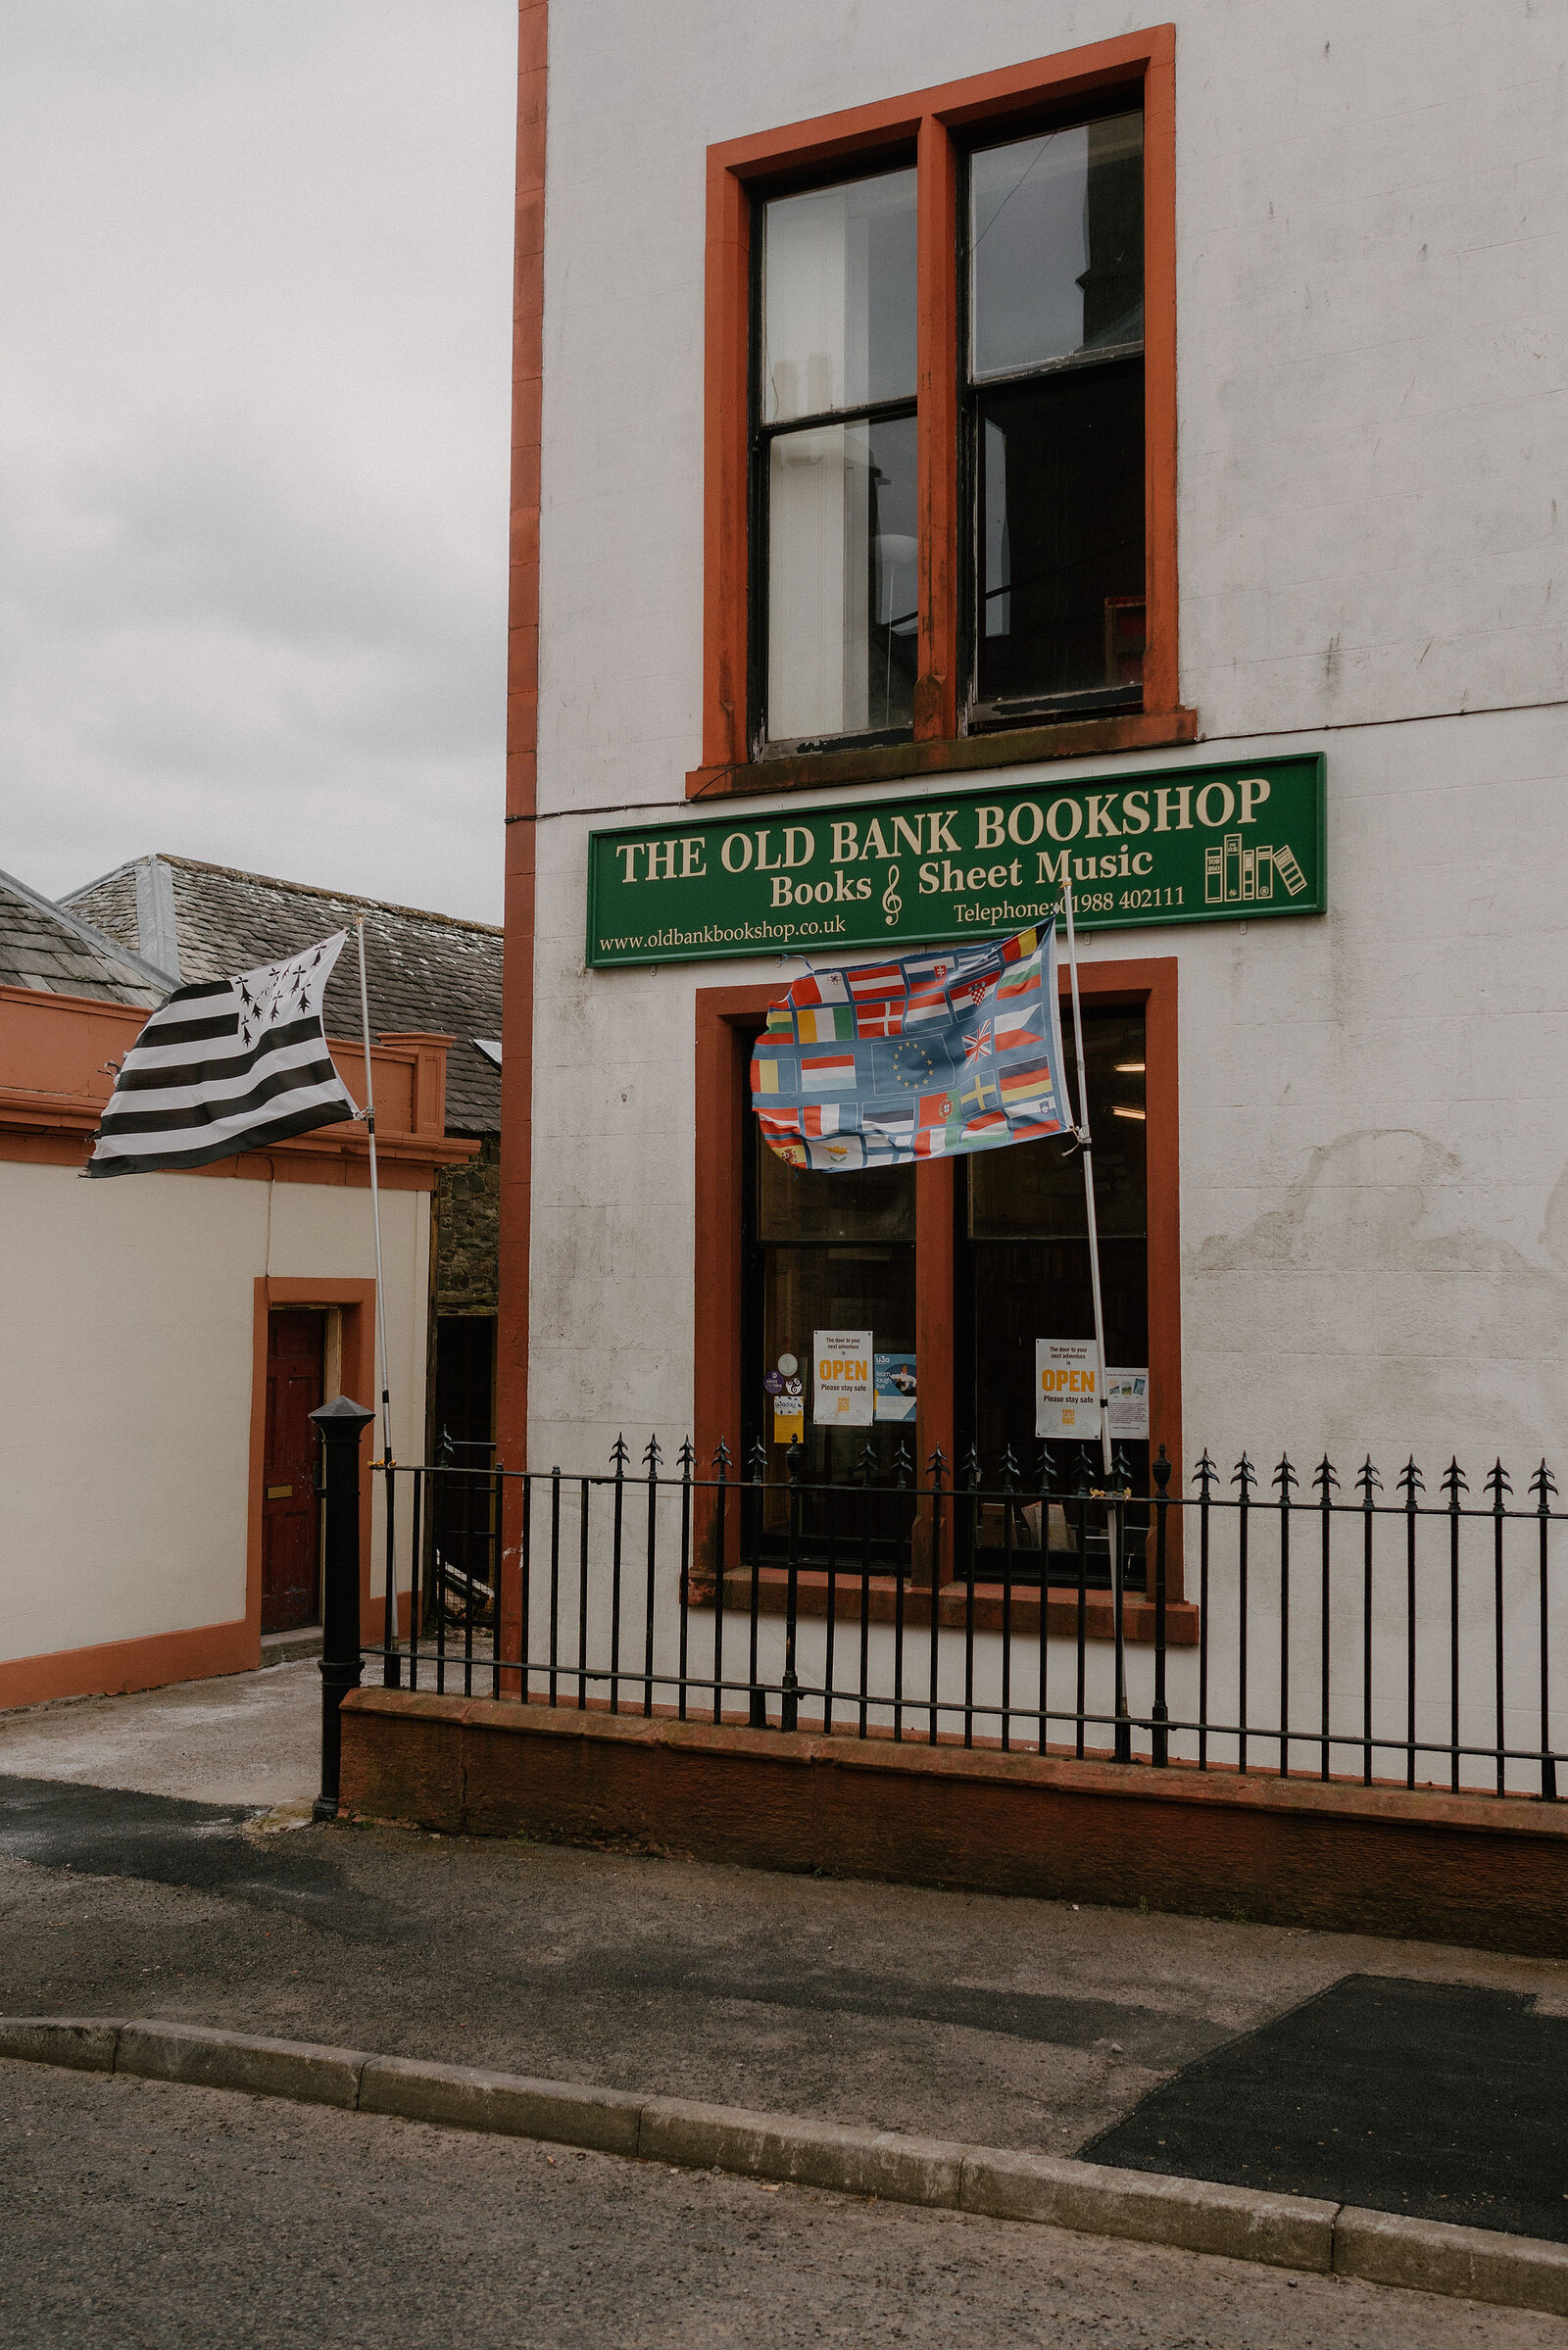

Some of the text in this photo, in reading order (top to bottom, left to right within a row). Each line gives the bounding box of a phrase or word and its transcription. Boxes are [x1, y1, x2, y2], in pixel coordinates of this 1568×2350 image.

[615, 777, 1272, 883] THE OLD BANK BOOKSHOP
[769, 844, 1154, 907] Books Sheet Music
[954, 900, 1055, 926] Telephone:
[1118, 886, 1185, 908] 402111
[599, 914, 847, 952] www.oldbankbookshop.co.uk
[819, 1359, 867, 1381] OPEN
[1042, 1369, 1095, 1393] OPEN
[841, 1384, 853, 1394] stay
[854, 1384, 866, 1393] safe
[1043, 1395, 1063, 1404] Please
[1064, 1396, 1078, 1405] stay
